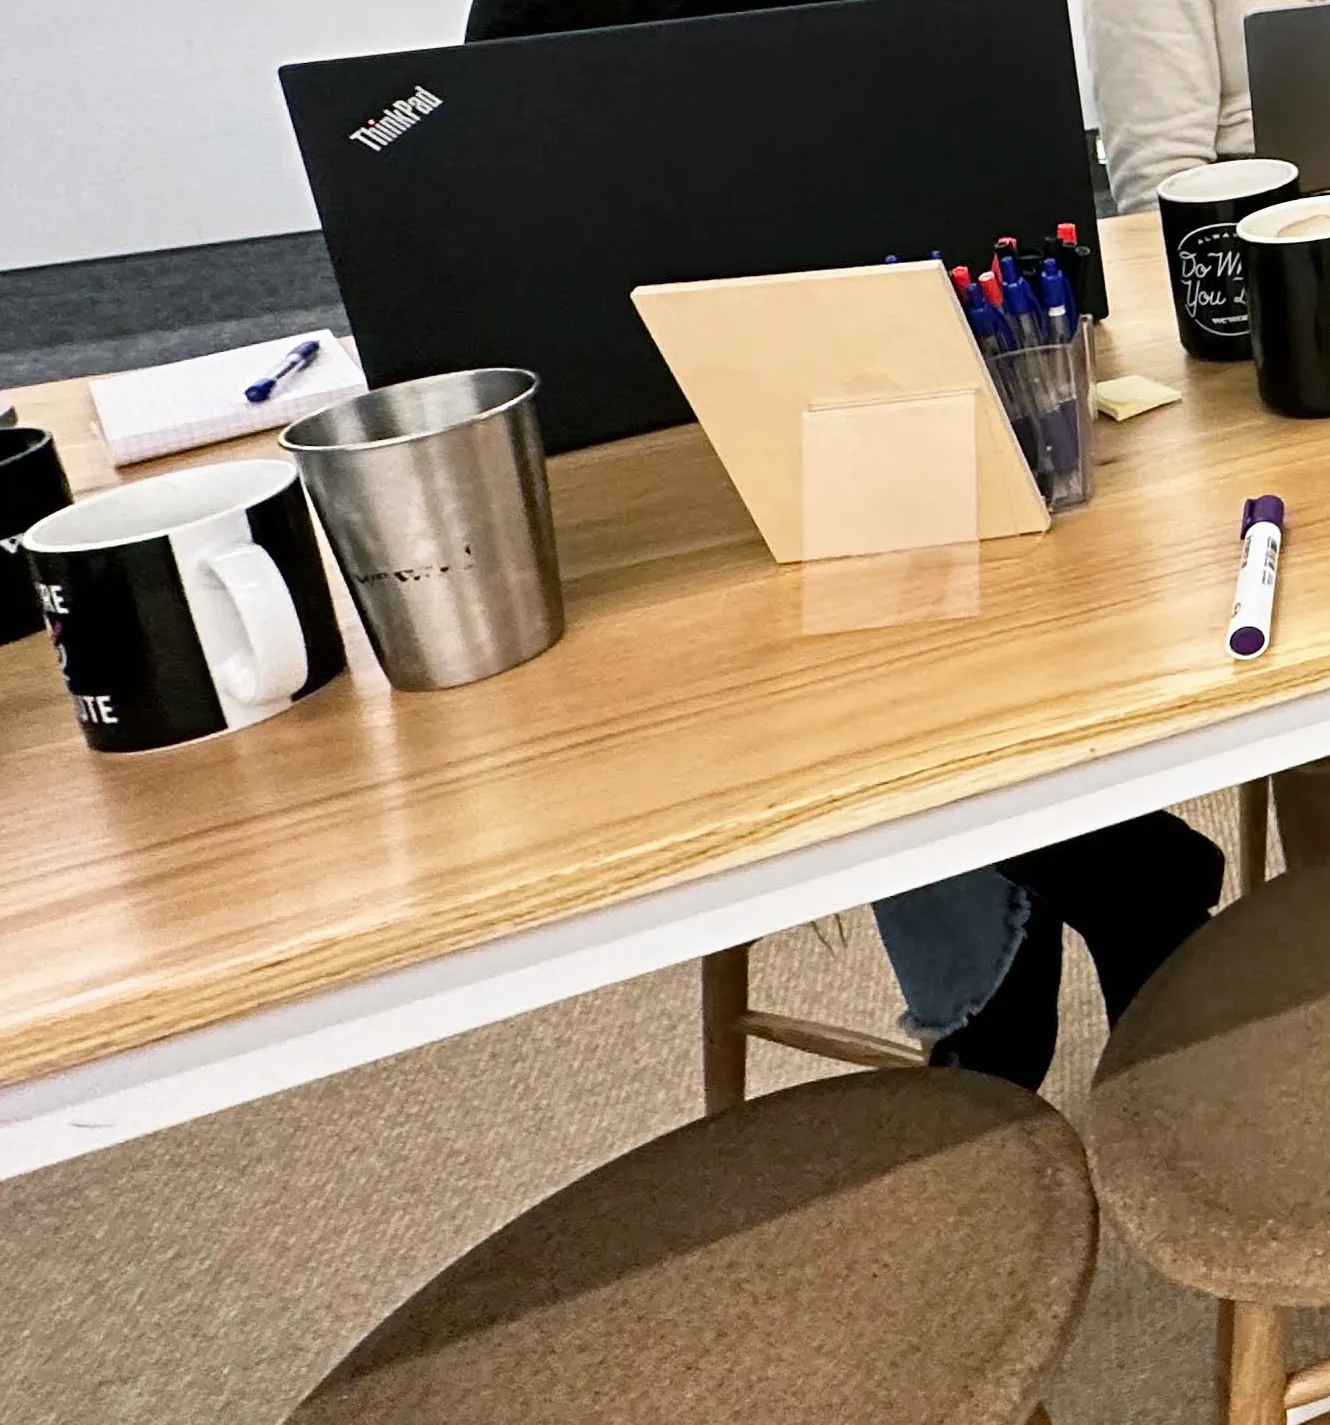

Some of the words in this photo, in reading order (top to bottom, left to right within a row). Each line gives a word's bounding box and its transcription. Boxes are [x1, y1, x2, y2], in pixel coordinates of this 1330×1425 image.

[348, 85, 443, 152] ThinkPad
[1179, 250, 1213, 279] Do
[1180, 279, 1228, 319] You
